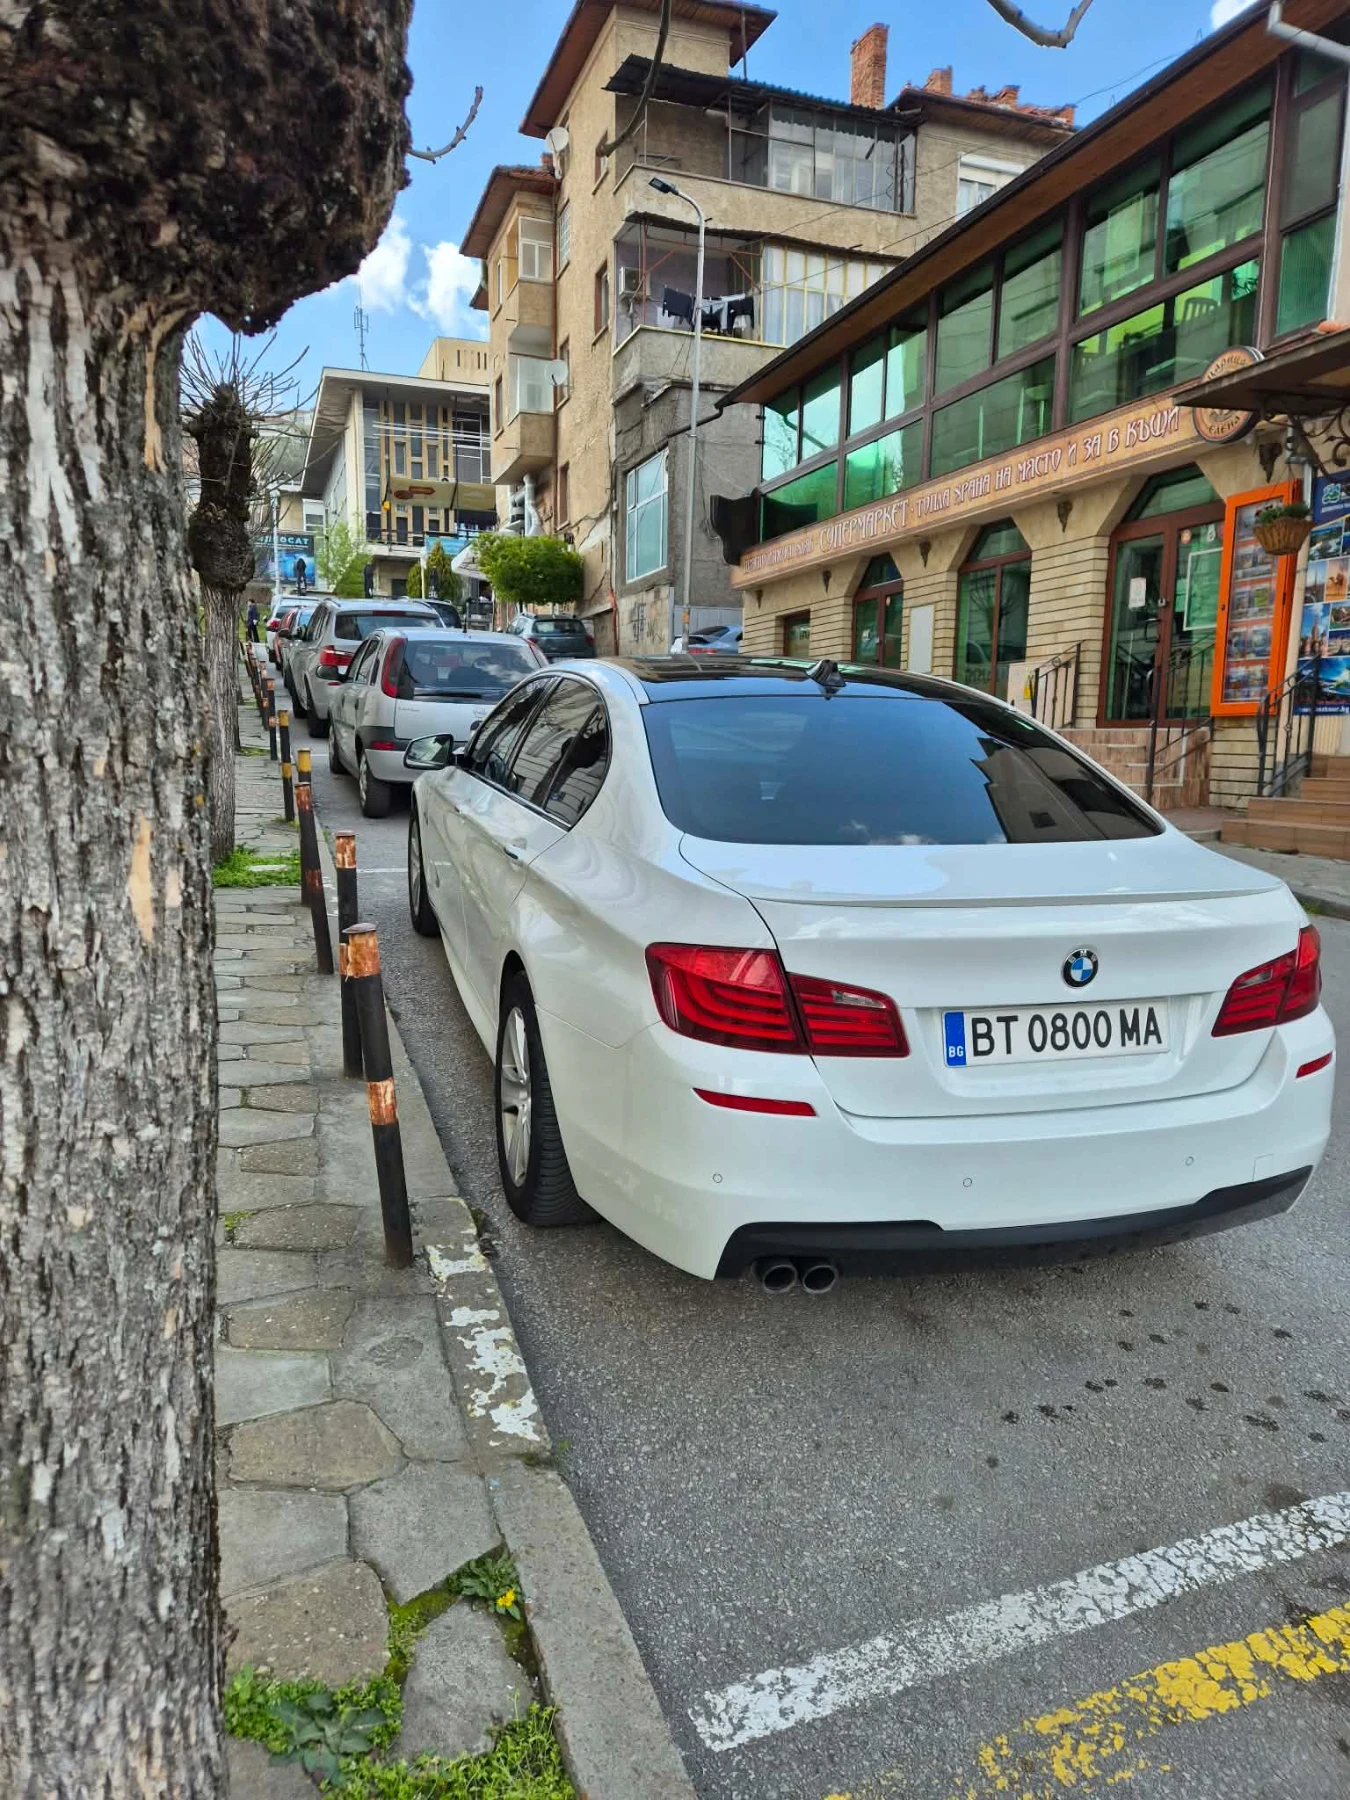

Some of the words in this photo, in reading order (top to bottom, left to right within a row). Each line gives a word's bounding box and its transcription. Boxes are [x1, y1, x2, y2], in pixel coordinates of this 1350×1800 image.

[818, 500, 908, 553] СУПЕРМАРКЕТ
[954, 473, 991, 506] ХРАНА
[995, 464, 1012, 491] НА
[1016, 448, 1062, 484] МЯСТО
[1083, 433, 1102, 462] ЗА
[1107, 428, 1119, 453] В
[1125, 406, 1180, 449] КЪЩИ
[948, 1045, 964, 1058] BG
[971, 1015, 1019, 1057] BT
[1028, 1010, 1112, 1053] 0800
[1119, 1007, 1163, 1048] MA
